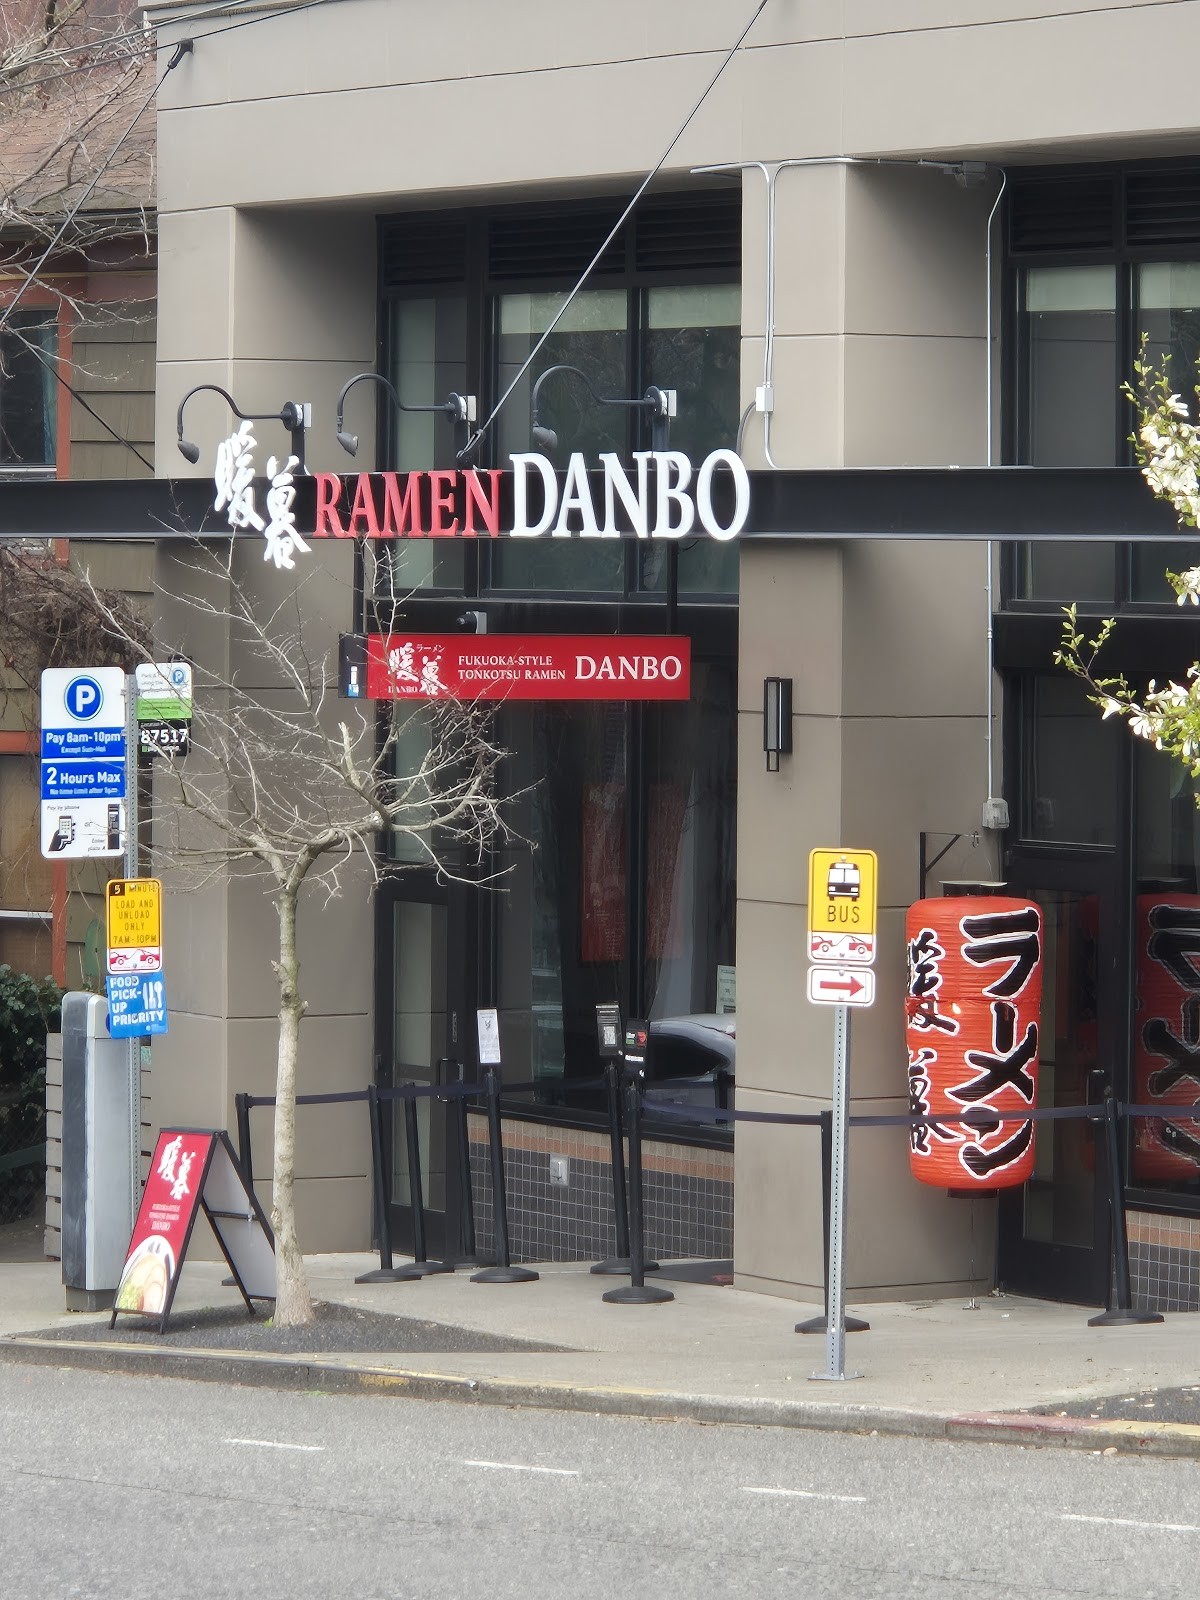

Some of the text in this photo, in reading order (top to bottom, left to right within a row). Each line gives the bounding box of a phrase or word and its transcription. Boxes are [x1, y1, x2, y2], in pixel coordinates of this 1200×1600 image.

[313, 449, 750, 541] RAMEN DANBO
[458, 655, 553, 666] FUKUOKA-STYLE
[458, 669, 566, 681] TONKOTSU RAMEN
[575, 656, 682, 681] DANBO
[76, 685, 95, 713] P
[46, 731, 120, 745] Pay 8am-10pm
[141, 729, 187, 743] 87517
[46, 767, 120, 785] 2 Hours Max
[114, 884, 121, 895] 5
[116, 899, 154, 909] LOAD AND
[118, 910, 150, 919] UNLOAD
[827, 905, 860, 923] BUS
[124, 922, 145, 931] ONLY
[110, 976, 139, 988] FOOD
[111, 988, 141, 1001] PICK-
[112, 1002, 127, 1014] UP
[113, 1010, 164, 1026] PRIORITY
[944, 906, 1040, 1179] ラーメン
